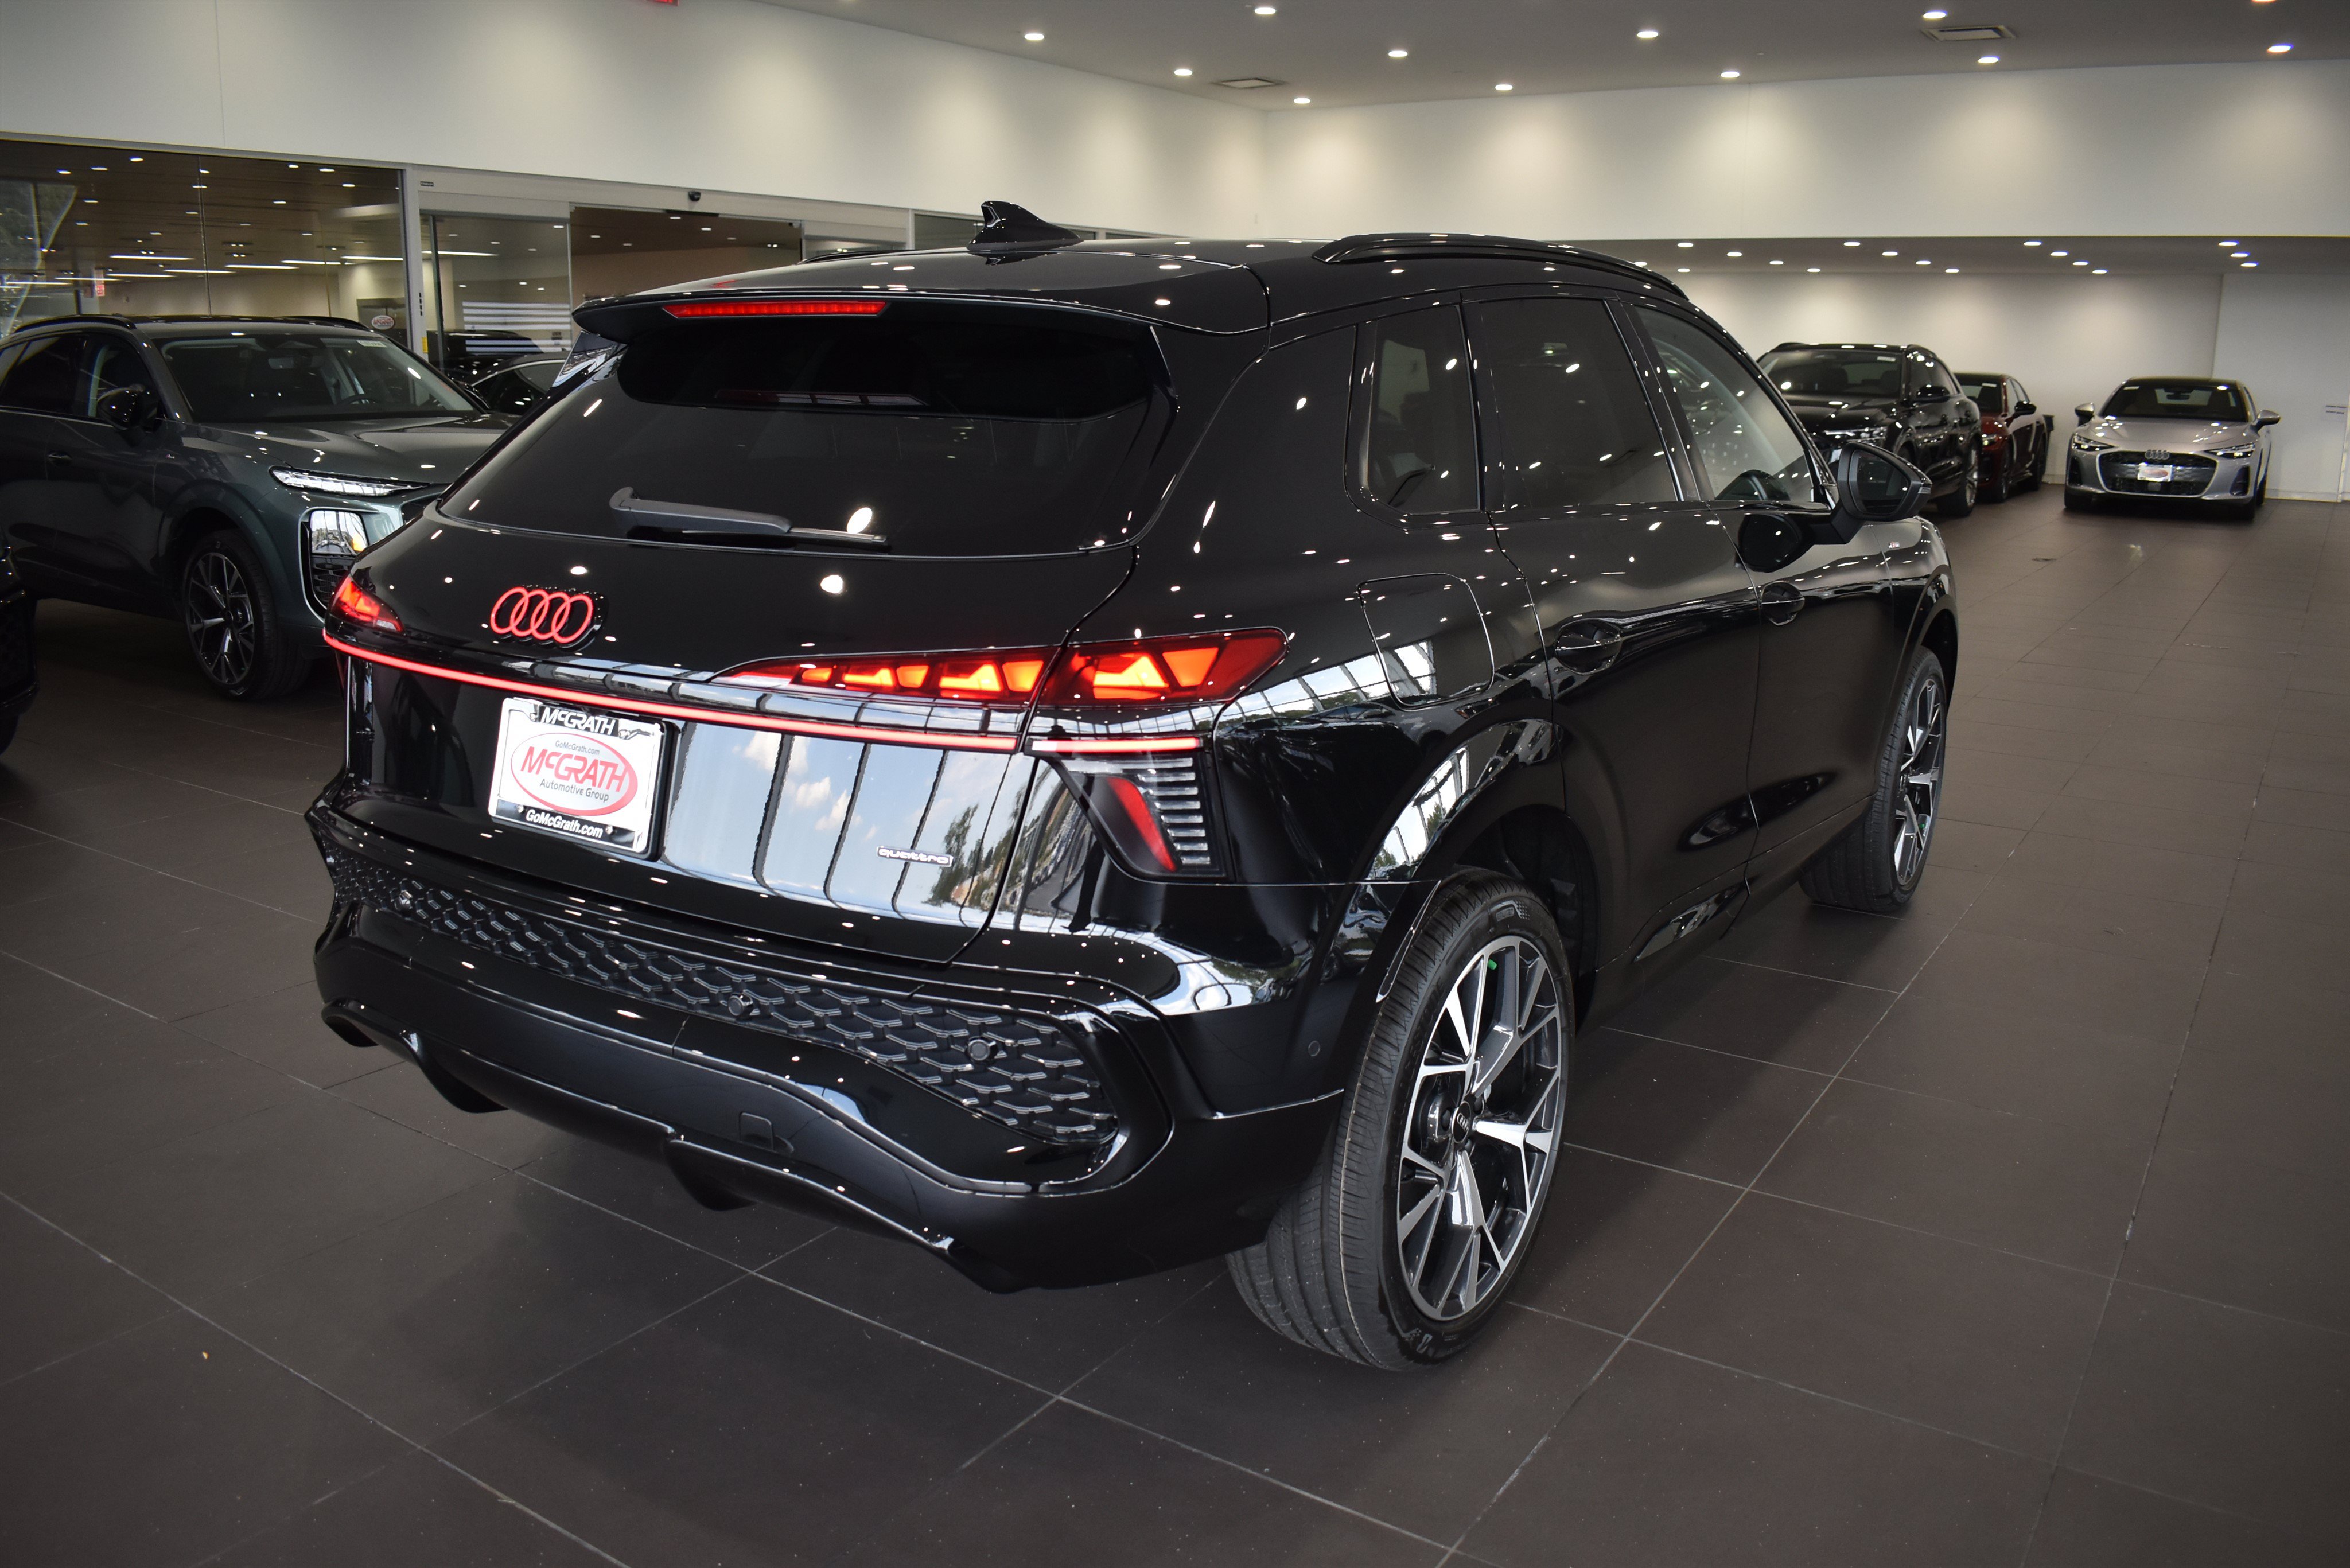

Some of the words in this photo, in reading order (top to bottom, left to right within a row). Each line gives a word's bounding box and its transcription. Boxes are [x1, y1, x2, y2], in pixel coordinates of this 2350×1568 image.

[541, 707, 616, 736] McGRATH
[555, 740, 600, 756] GoMcGrath.com
[520, 746, 628, 792] McGRATH
[540, 778, 584, 796] Automotive
[585, 787, 609, 803] Group
[526, 809, 604, 839] GoMcGrath.com
[878, 848, 949, 865] quattro
